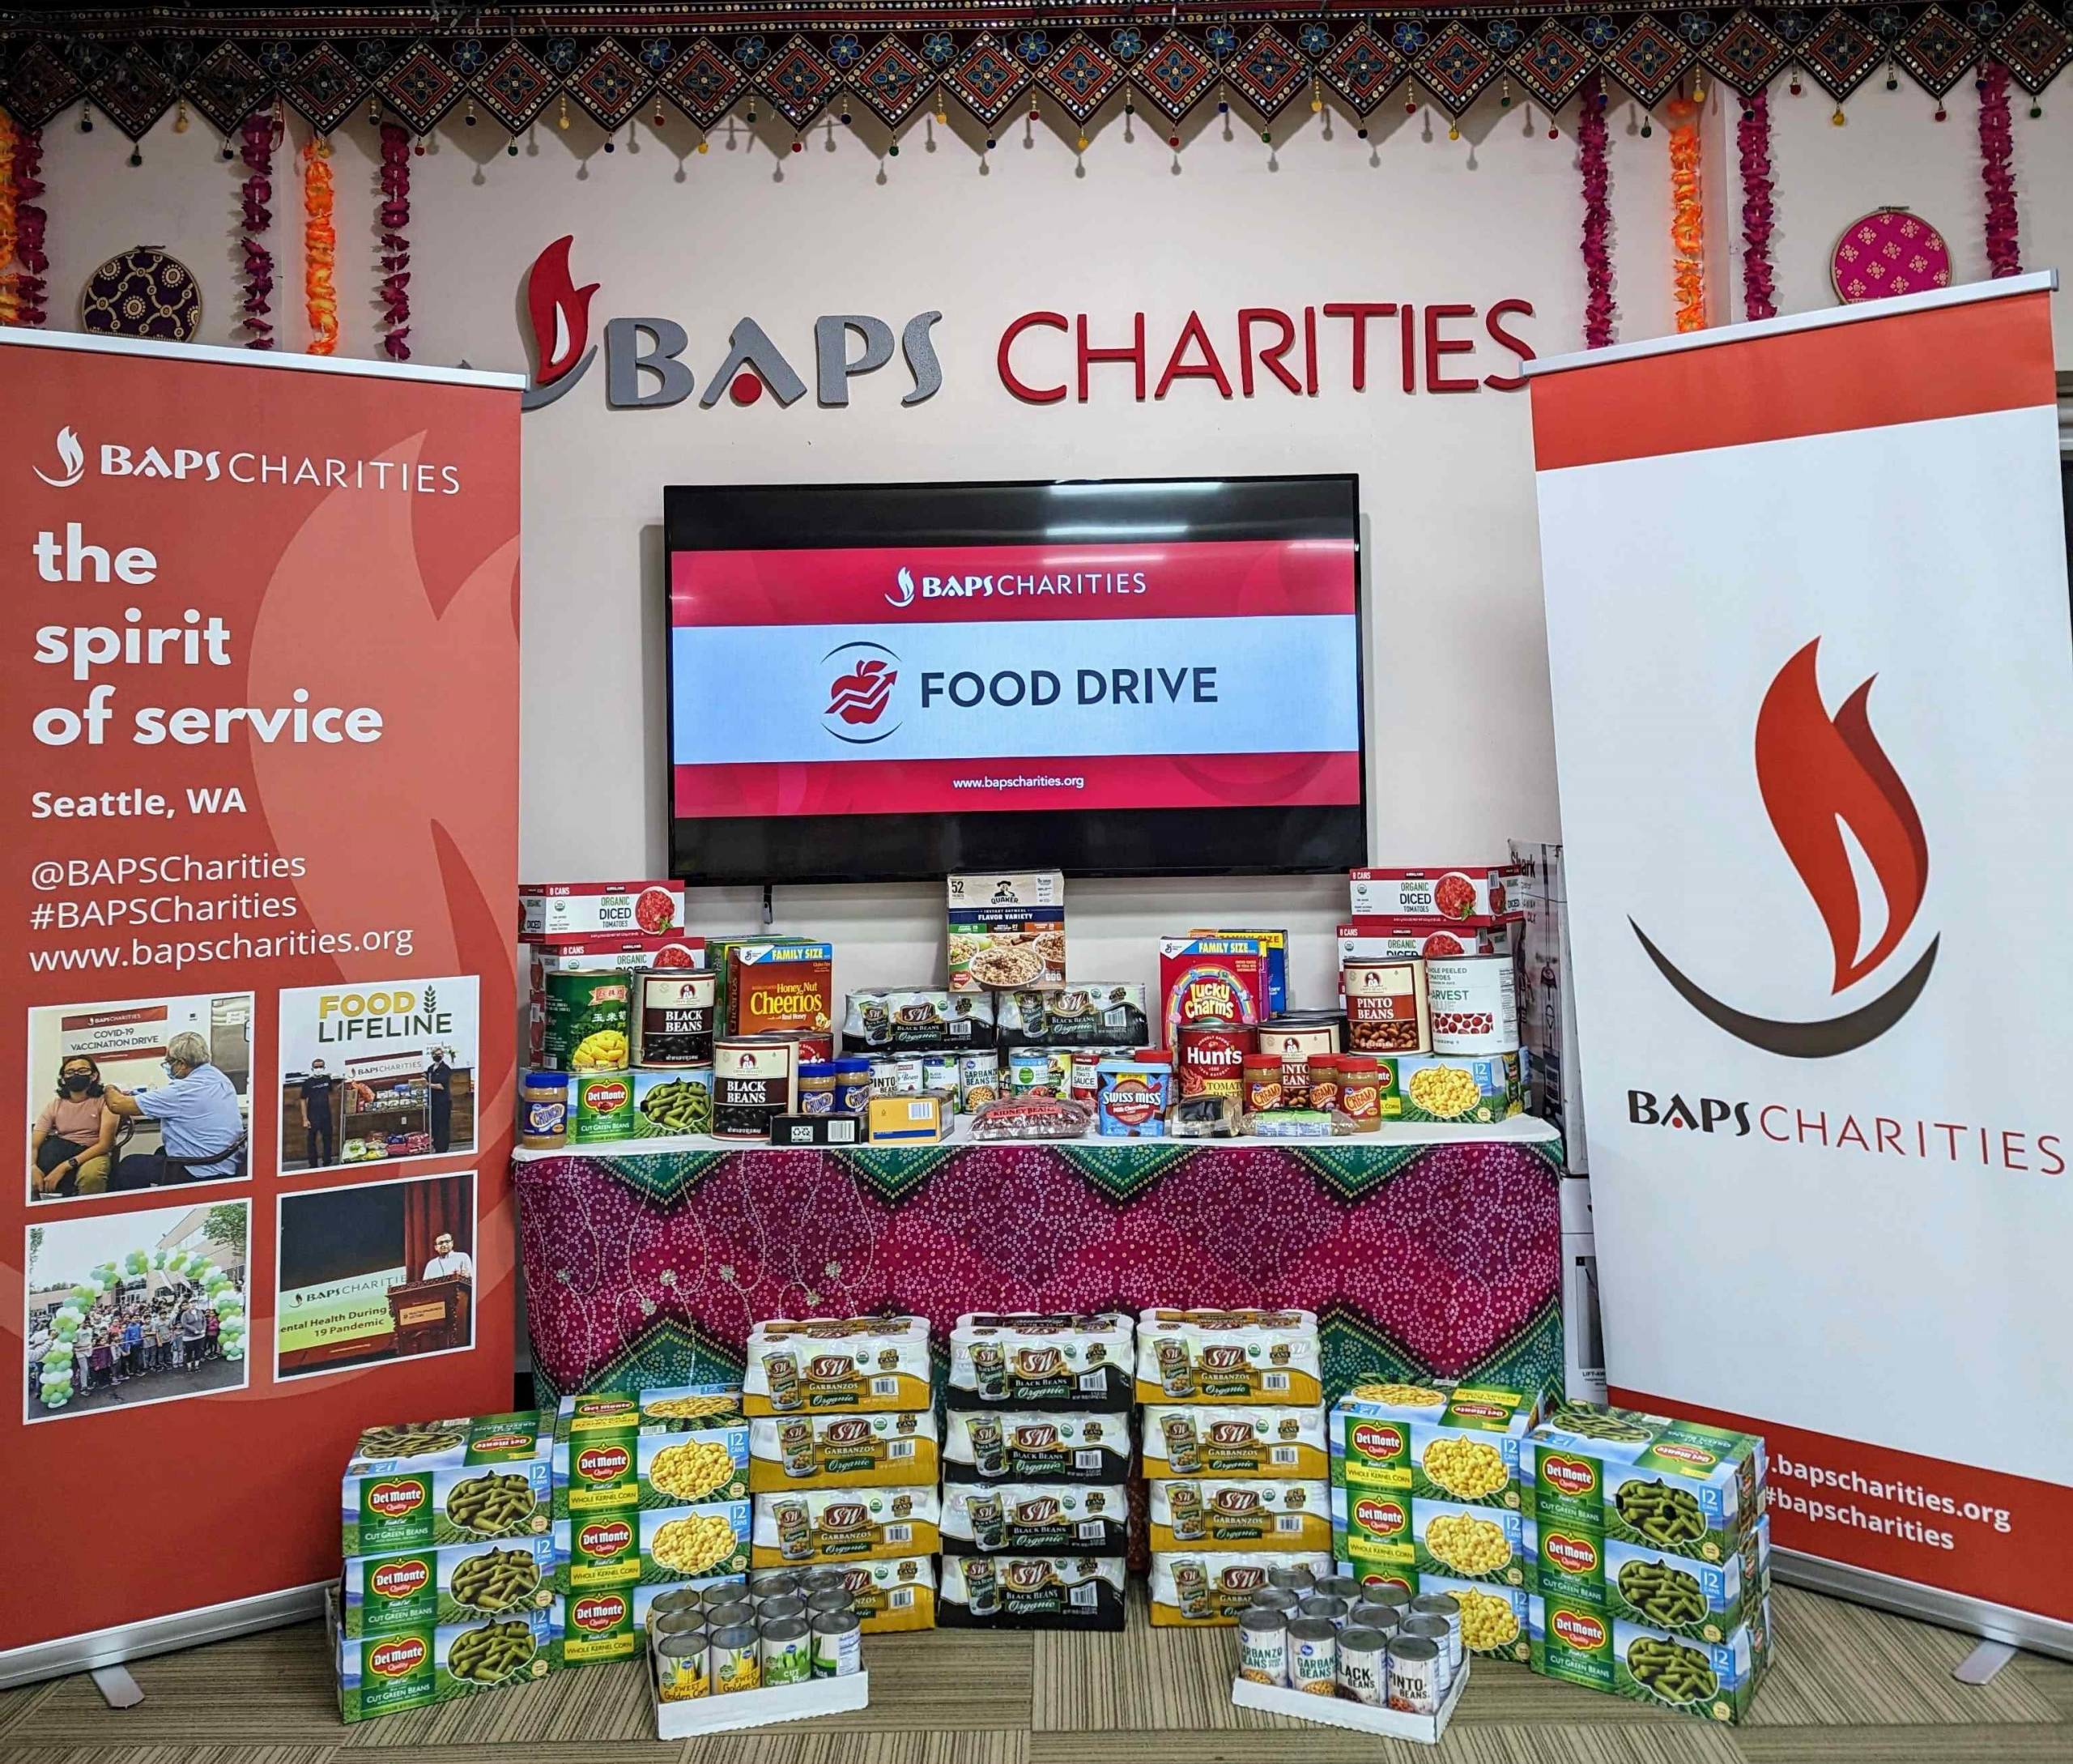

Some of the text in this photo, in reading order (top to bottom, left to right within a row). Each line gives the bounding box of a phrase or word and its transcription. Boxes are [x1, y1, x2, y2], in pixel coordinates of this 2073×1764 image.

[608, 300, 1534, 409] BAPS CHARITIES
[33, 522, 157, 585] the
[33, 607, 231, 680] spirit
[921, 667, 1218, 709] FOOD DRIVE
[32, 684, 382, 745] of service
[953, 775, 1083, 790] www.bapscharities.org
[32, 787, 246, 820] Seattle, WA
[32, 853, 306, 891] @BAPSCharities
[555, 887, 569, 895] CANS
[951, 881, 964, 893] 52
[1401, 883, 1428, 891] ORGANIC
[601, 897, 629, 906] ORGANIC
[991, 897, 1019, 905] QUAKER
[1400, 893, 1432, 905] DICED
[30, 893, 297, 930] #BAPSCharities
[599, 908, 632, 920] DICED
[29, 927, 414, 971] www.bapscharities.org
[568, 946, 584, 954] CANS
[1199, 943, 1249, 952] FAMILY SIZE
[1388, 940, 1416, 948] ORGANIC
[617, 954, 647, 964] ORGANIC
[773, 948, 823, 960] FAMILY SIZE
[777, 982, 817, 995] Honey Nut
[1190, 983, 1230, 1003] Lucky
[319, 991, 415, 1019] FOOD
[751, 992, 822, 1015] Cheerios
[1185, 1000, 1233, 1019] Charms
[1357, 998, 1393, 1008] PINTO
[666, 1011, 703, 1020] BLACK
[1357, 1008, 1394, 1019] BEANS
[318, 1013, 452, 1042] LIFELINE
[666, 1021, 702, 1032] BEANS
[1054, 1024, 1092, 1034] Organic
[94, 1028, 134, 1039] COVID-19
[899, 1032, 937, 1042] Organic
[70, 1035, 159, 1051] VACCINATION DRIVE
[1188, 1046, 1242, 1065] Hunt's
[1475, 1064, 1486, 1076] 12
[727, 1081, 766, 1092] BLACK
[966, 1077, 989, 1085] BEANS
[589, 1090, 625, 1101] Del Monte
[728, 1093, 766, 1103] BEANS
[1103, 1092, 1133, 1104] SWISS
[1254, 1084, 1282, 1104] CREAMY
[1310, 1084, 1337, 1103] CREAMY
[1347, 1089, 1377, 1110] CREAMY
[534, 1106, 564, 1126] CRUNCHY
[994, 1108, 1028, 1116] KIDNEY
[310, 1314, 346, 1327] Health
[348, 1306, 386, 1321] During
[314, 1319, 384, 1337] 19 Pandemic
[1017, 1387, 1064, 1400] Organic
[1206, 1385, 1245, 1396] Organic
[813, 1395, 854, 1405] Organic
[730, 1434, 744, 1446] 12
[1356, 1433, 1400, 1447] Del Monte
[1504, 1440, 1517, 1453] 12
[824, 1447, 875, 1455] GARBANZOS
[581, 1456, 626, 1468] Del Monte
[828, 1459, 870, 1471] Organic
[532, 1466, 547, 1479] 12
[1348, 1469, 1410, 1483] WHOLE CORN
[1547, 1464, 1592, 1484] Del Monte
[373, 1489, 421, 1504] Del Monte
[595, 1493, 618, 1502] KERNEL
[1702, 1489, 1717, 1505] 12
[1764, 1455, 2011, 1532] .bapscharities.org
[733, 1506, 747, 1519] 12
[1359, 1508, 1402, 1523] Del Monte
[1541, 1502, 1599, 1522] CUT GREEN BEANS
[1506, 1518, 1520, 1532] 12
[365, 1528, 428, 1540] CUT GREEN BEANS
[583, 1532, 628, 1545] Del Monte
[821, 1532, 871, 1540] GARBANZOS
[537, 1540, 551, 1553] 12
[1351, 1545, 1372, 1553] WHOLE
[1565, 1547, 1594, 1562] Monte
[376, 1570, 425, 1585] Del Monte
[1559, 1583, 1580, 1594] GREEN
[1007, 1591, 1032, 1600] BLACK
[368, 1608, 432, 1623] CUT GREEN BEANS
[723, 1680, 751, 1692] Golden
[1390, 1671, 1424, 1690] PINTO
[367, 1690, 406, 1703] CUT GREEN
